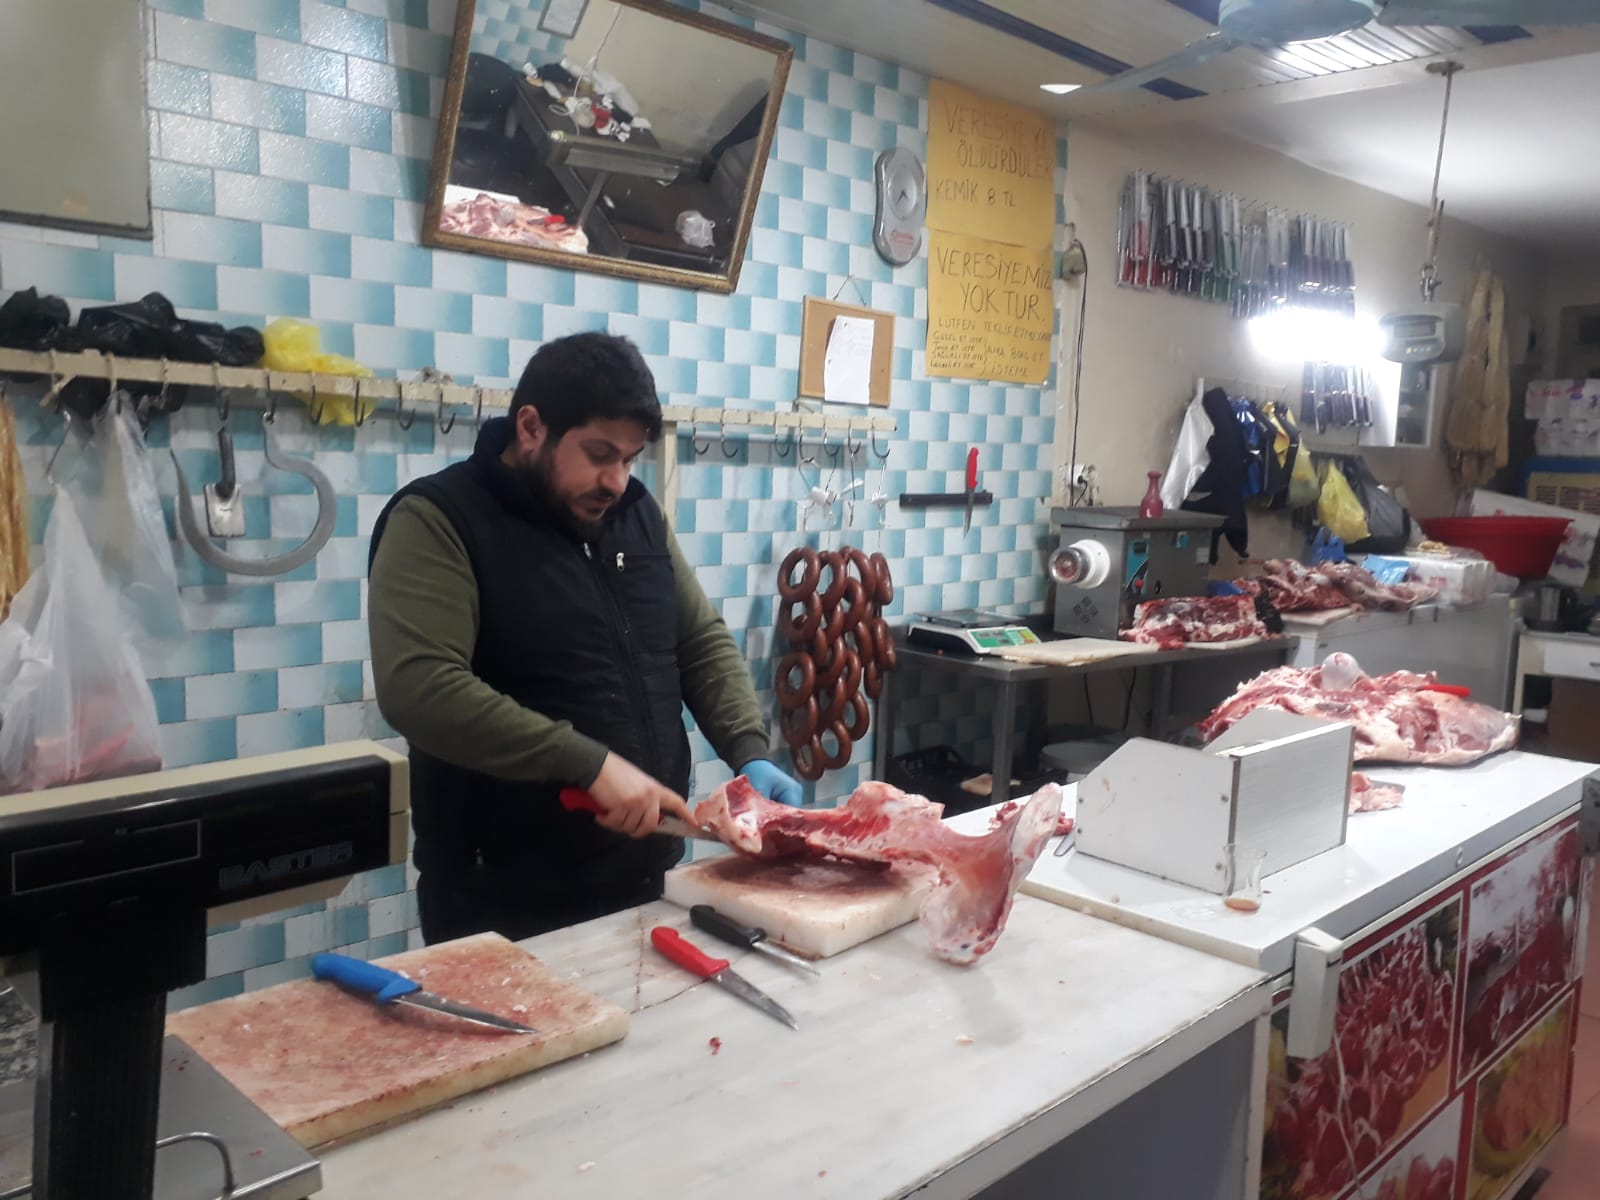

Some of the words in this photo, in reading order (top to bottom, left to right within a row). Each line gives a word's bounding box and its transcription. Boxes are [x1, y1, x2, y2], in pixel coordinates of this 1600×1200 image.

[987, 187, 996, 206] 8
[1004, 191, 1017, 208] TL
[960, 282, 999, 313] YOK
